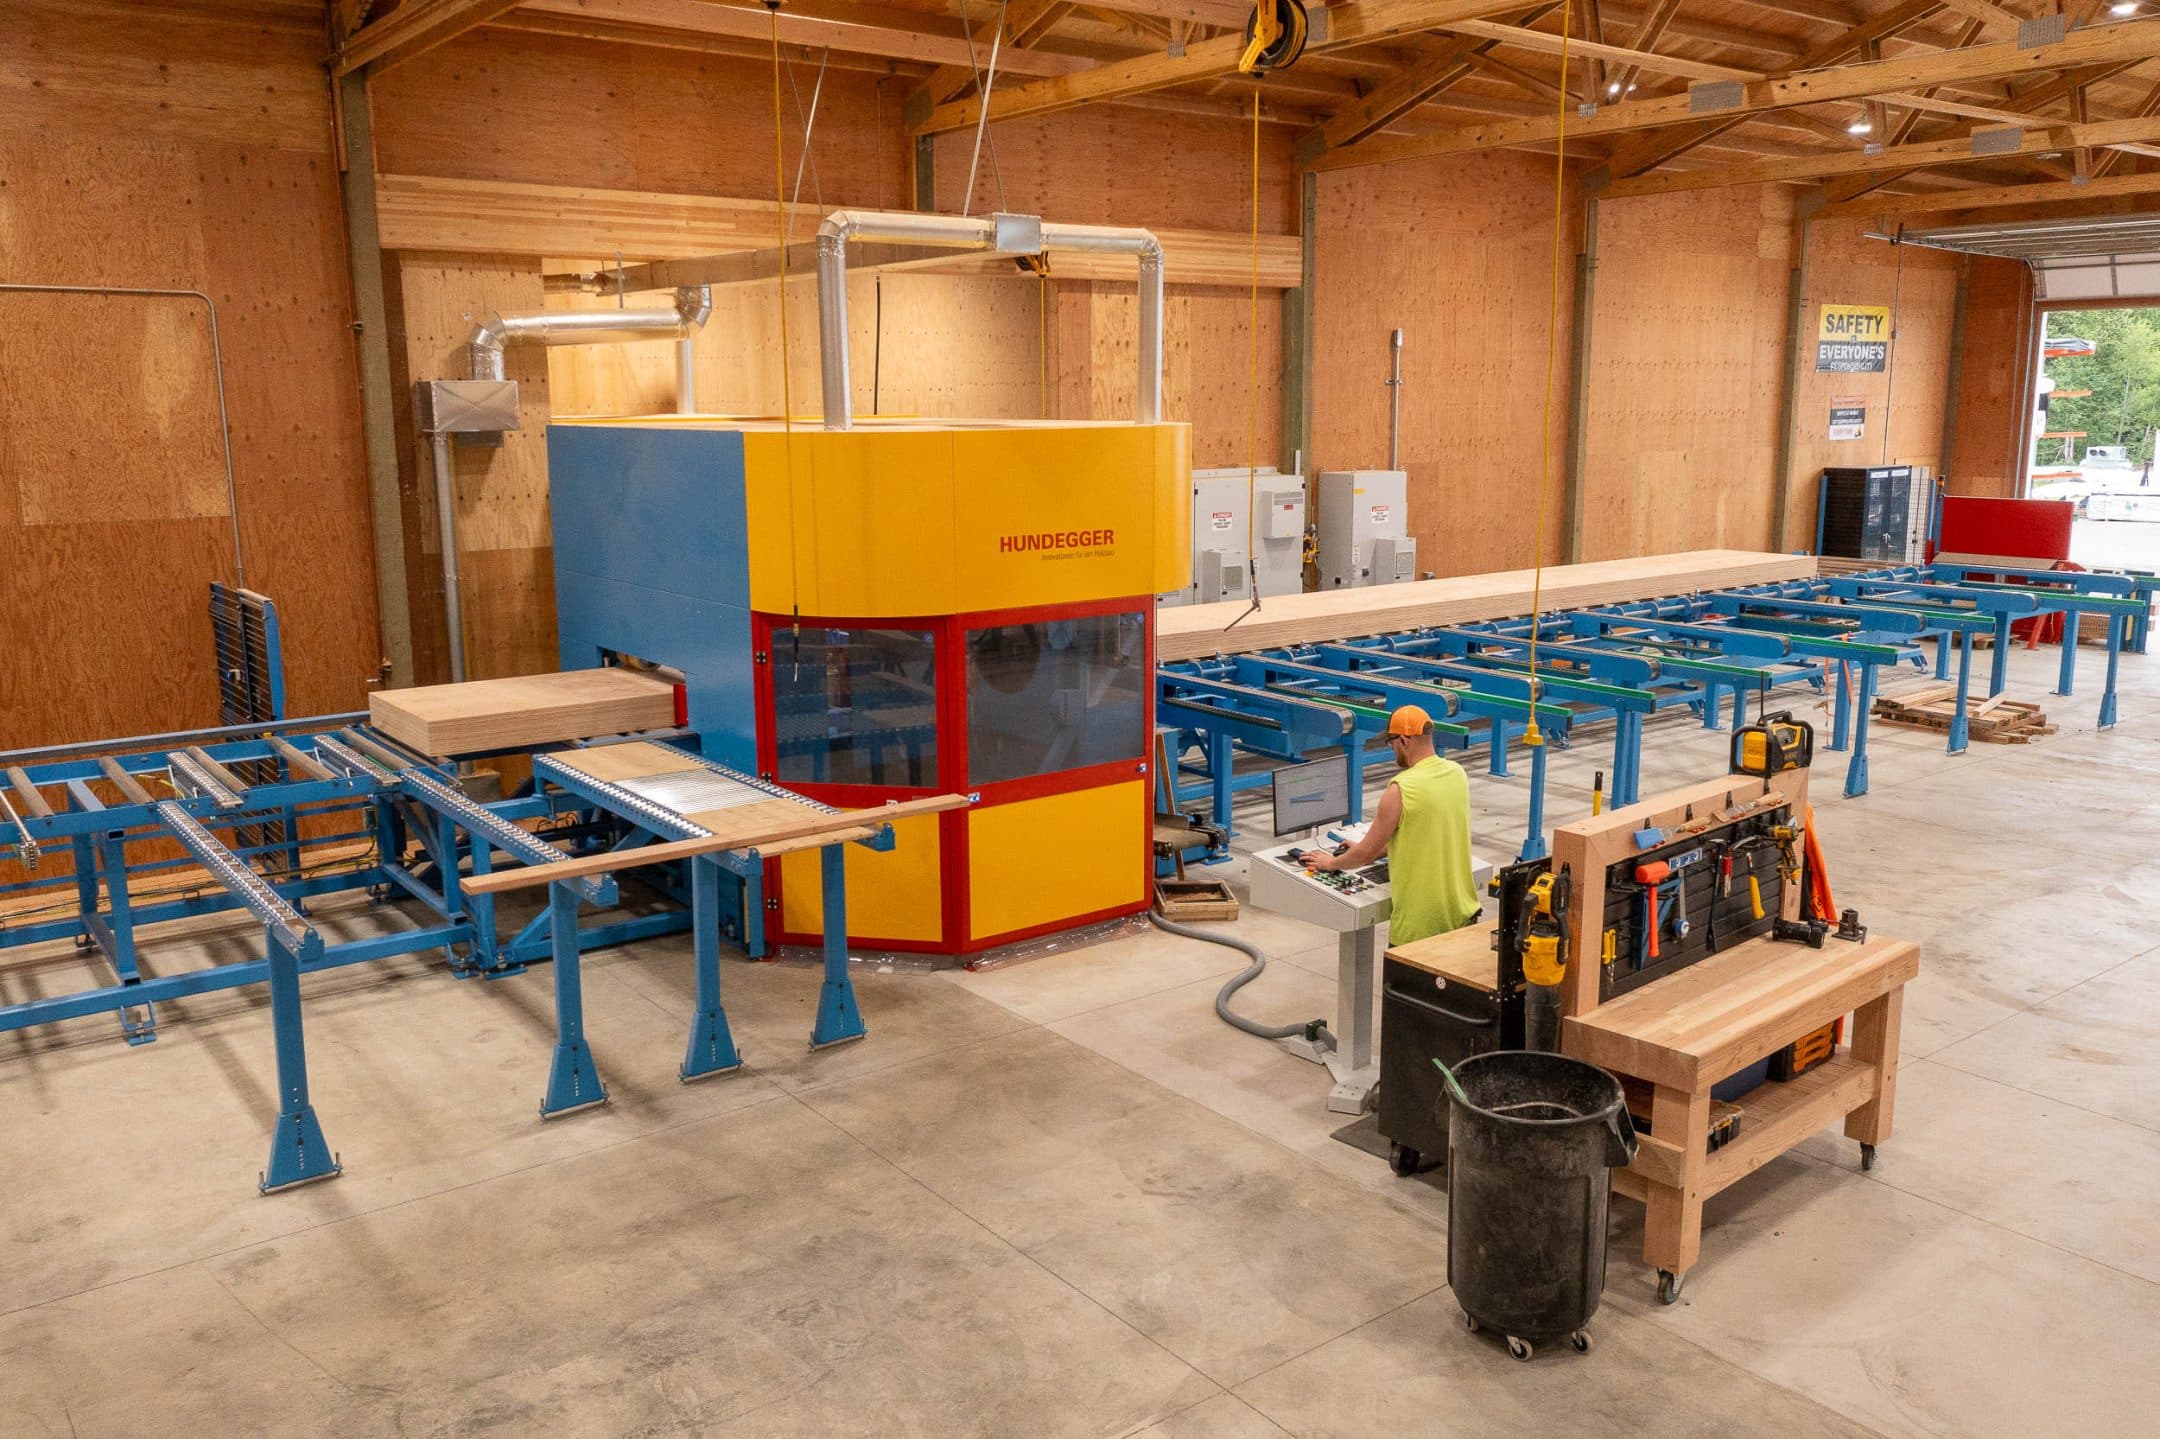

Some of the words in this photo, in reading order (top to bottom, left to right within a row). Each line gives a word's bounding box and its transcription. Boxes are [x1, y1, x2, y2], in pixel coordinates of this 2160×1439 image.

[1825, 313, 1884, 335] SAFETY
[1819, 344, 1885, 360] EVERYONE'S
[1000, 529, 1114, 552] HUNDEGGER
